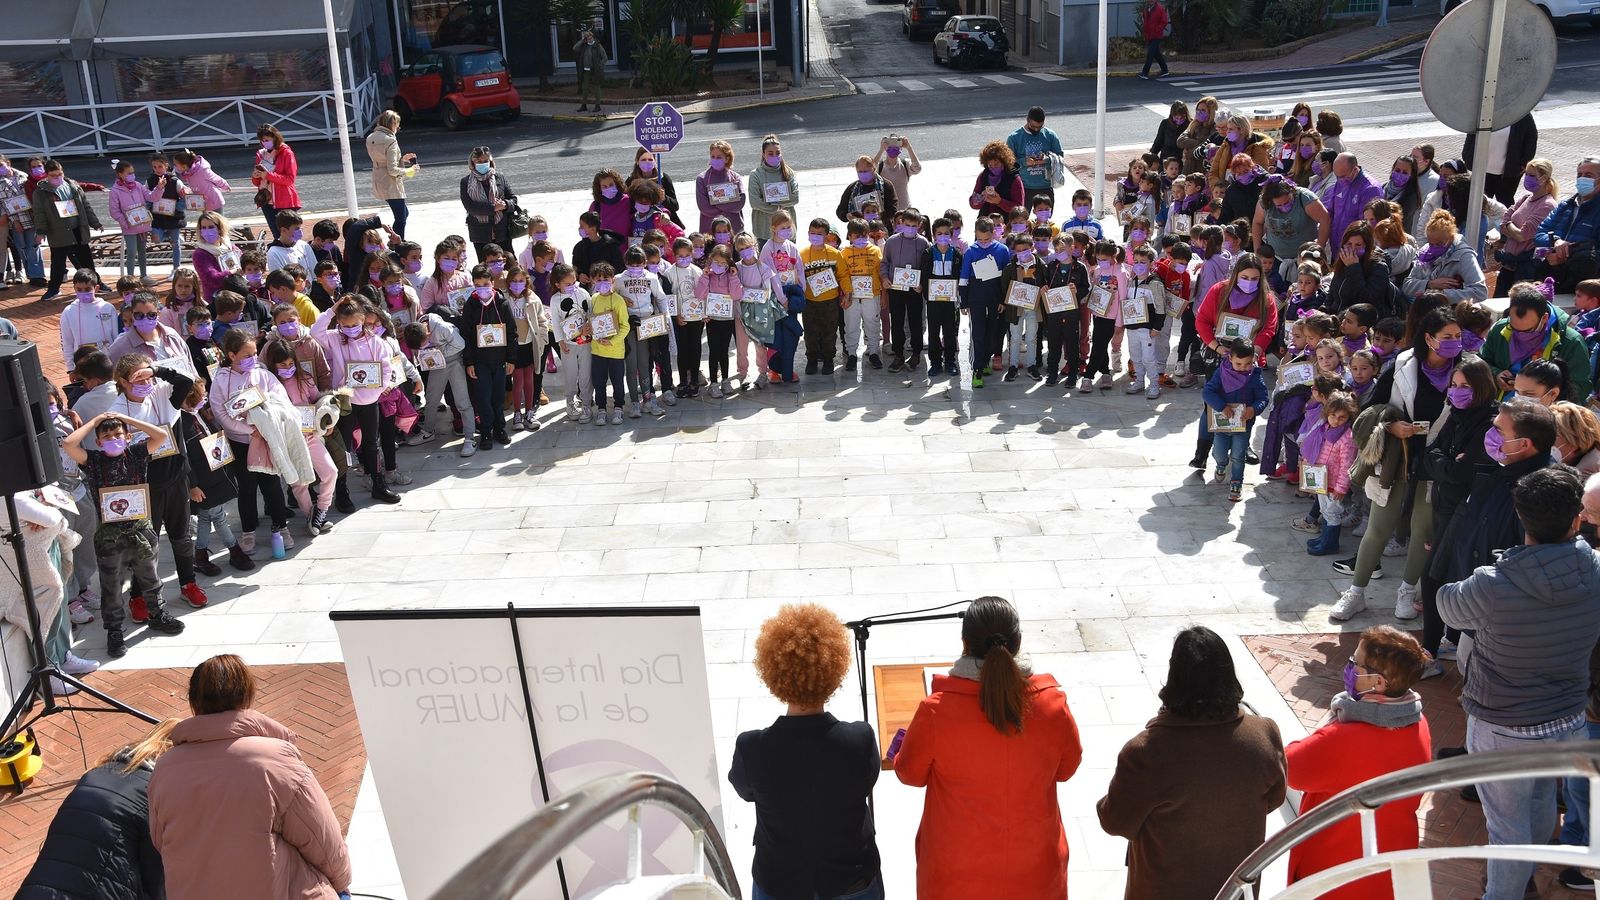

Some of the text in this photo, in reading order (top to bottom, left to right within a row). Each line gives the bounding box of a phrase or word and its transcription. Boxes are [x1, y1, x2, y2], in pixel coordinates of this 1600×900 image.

[645, 116, 672, 126] STOP
[640, 126, 678, 134] VIOLENCIA
[822, 274, 832, 284] 14
[909, 273, 916, 282] 9
[863, 281, 872, 289] 22
[697, 301, 704, 310] 4
[720, 303, 730, 312] 11
[1303, 367, 1311, 378] 3
